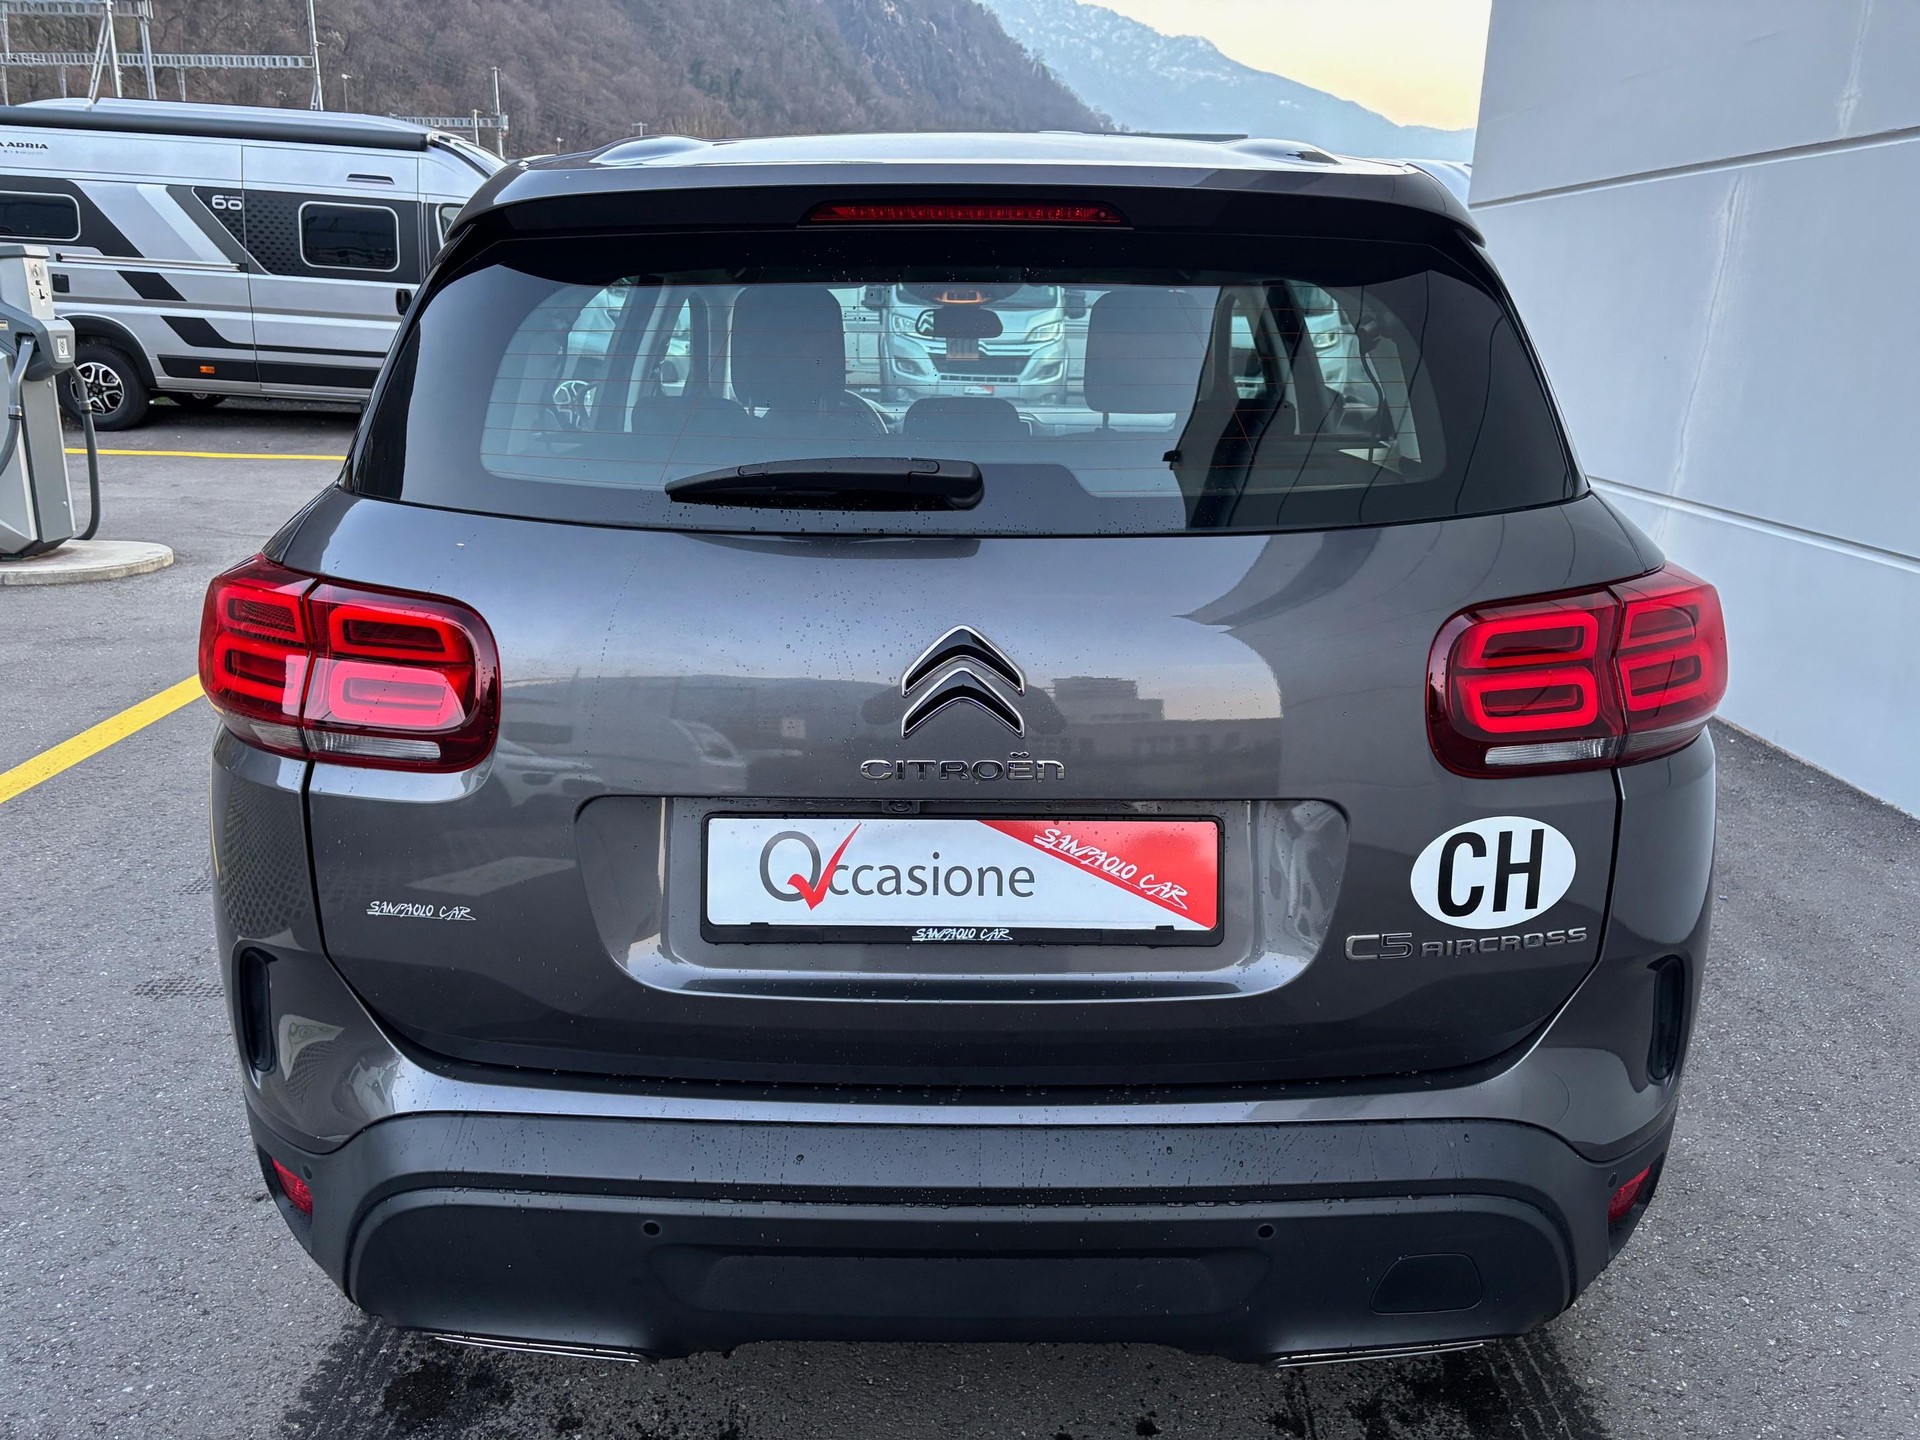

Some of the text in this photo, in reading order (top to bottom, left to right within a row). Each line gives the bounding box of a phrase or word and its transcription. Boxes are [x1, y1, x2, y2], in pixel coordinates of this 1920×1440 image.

[6, 141, 49, 150] ADRIA
[211, 194, 243, 210] 60
[1033, 828, 1189, 910] SANPAOLO CAR
[1437, 828, 1545, 918] CH
[367, 901, 476, 920] SANPAOLO CAR
[912, 927, 1013, 941] SANPAOLO CAR
[1344, 927, 1588, 960] C5 AIRCROSS
